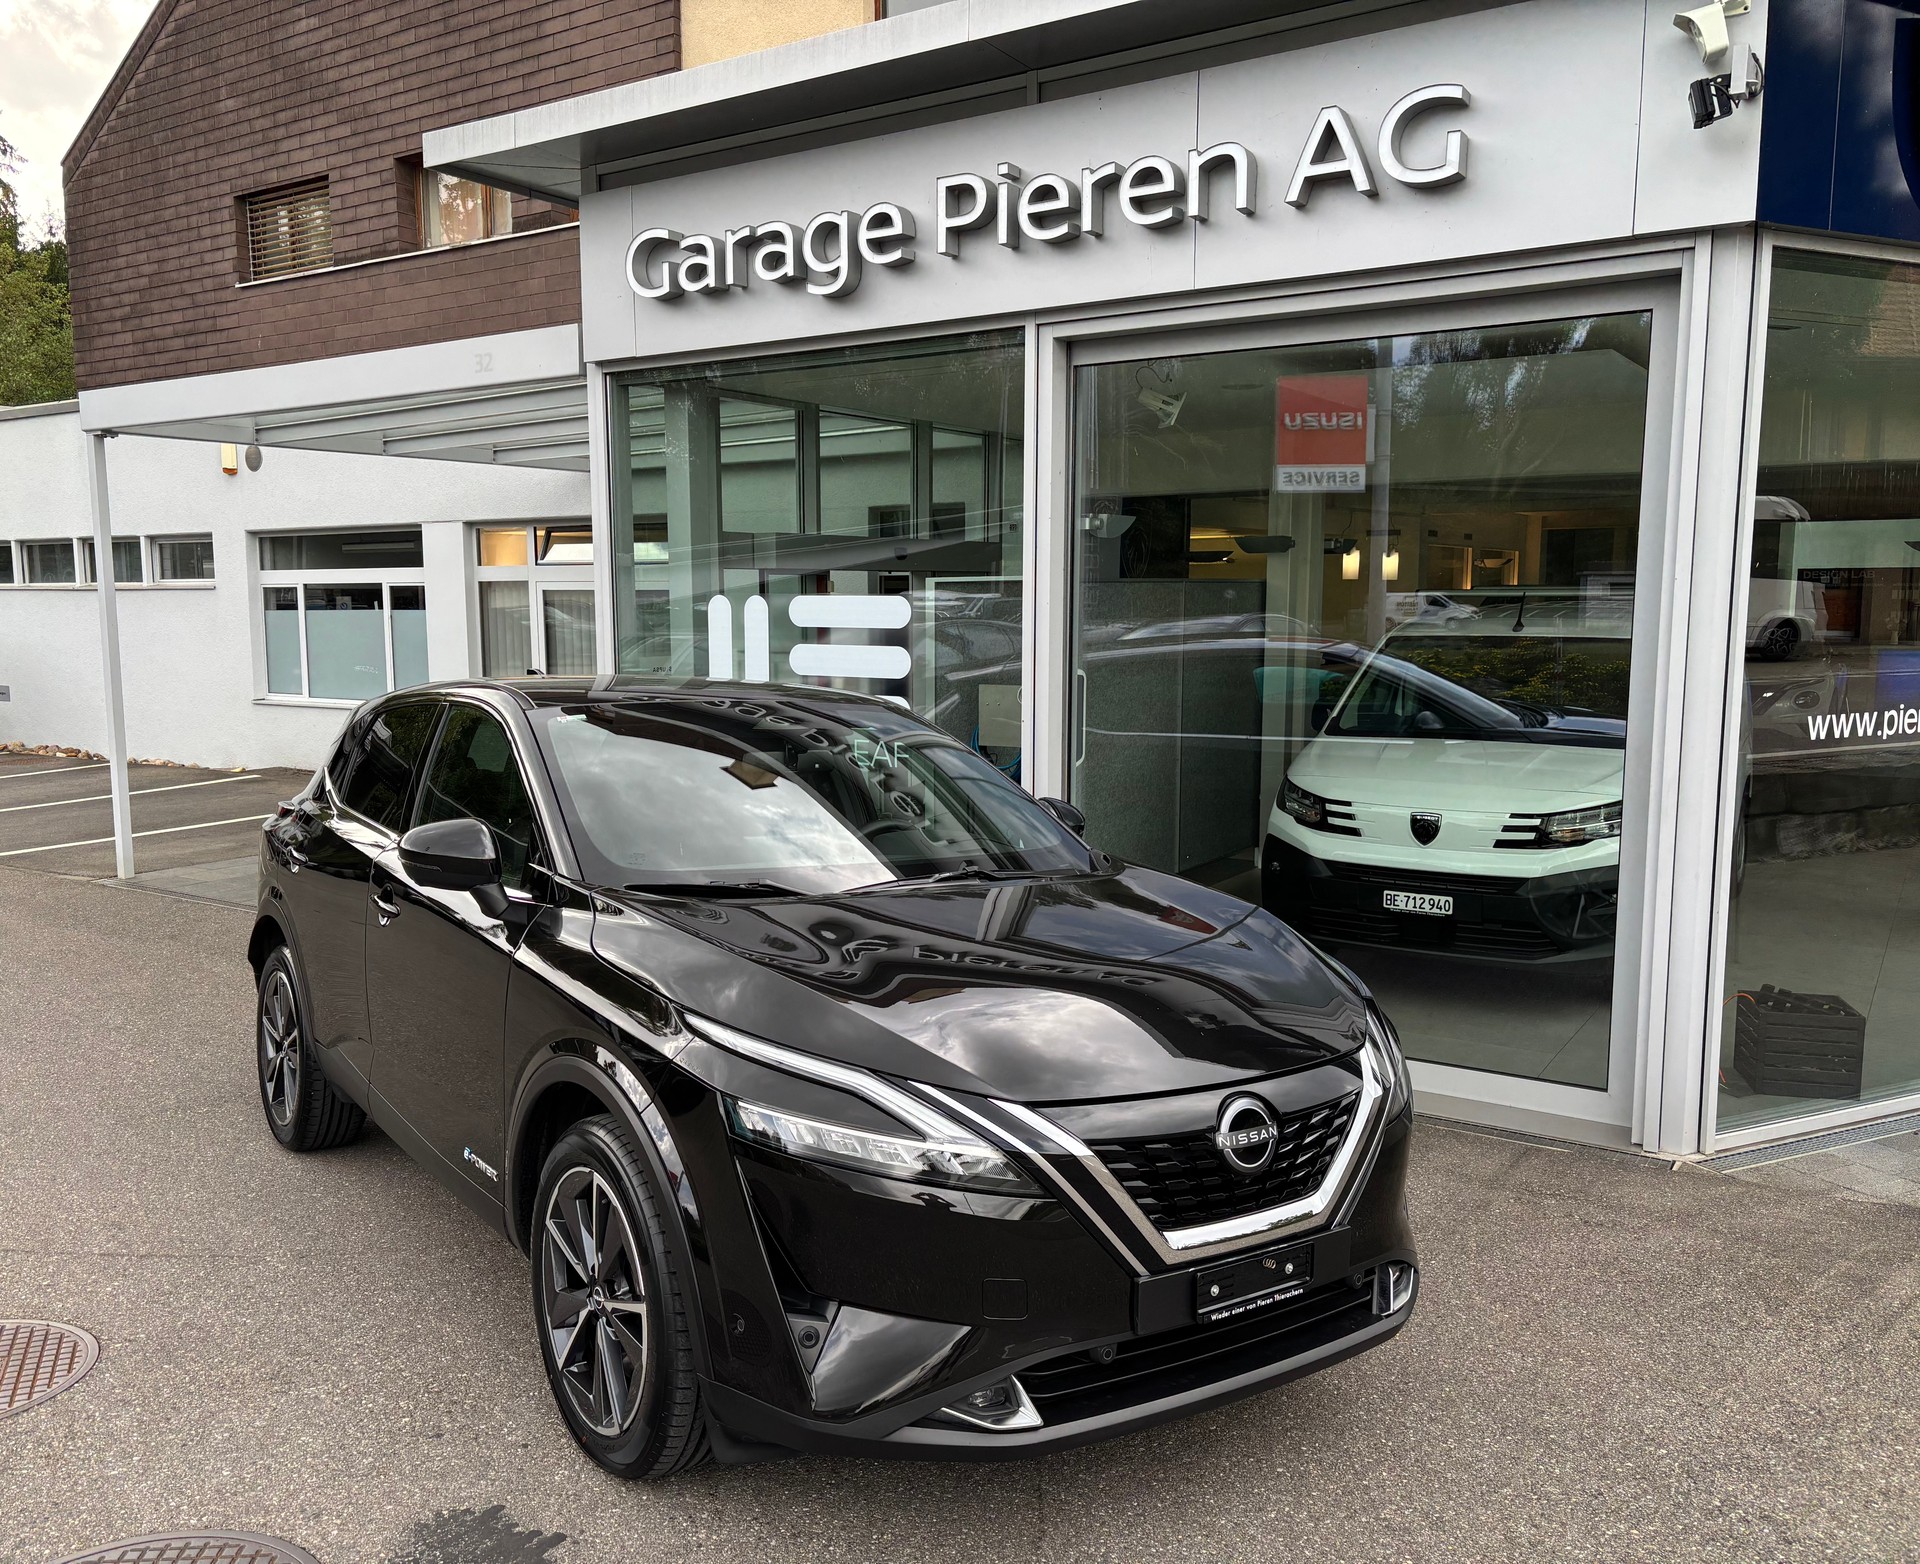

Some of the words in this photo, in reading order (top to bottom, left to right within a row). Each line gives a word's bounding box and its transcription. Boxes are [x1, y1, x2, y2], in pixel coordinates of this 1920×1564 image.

[625, 201, 916, 300] Garage
[936, 141, 1257, 258] Pieren
[1284, 83, 1471, 208] AG
[474, 352, 493, 373] 32
[1803, 570, 1848, 579] DESIGN
[1851, 570, 1875, 579] LAB
[1808, 704, 1920, 741] www.pie
[1218, 1125, 1277, 1148] NISSAN
[1210, 1310, 1231, 1321] Wieder
[1232, 1306, 1246, 1315] einer
[1257, 1298, 1273, 1307] Pieren
